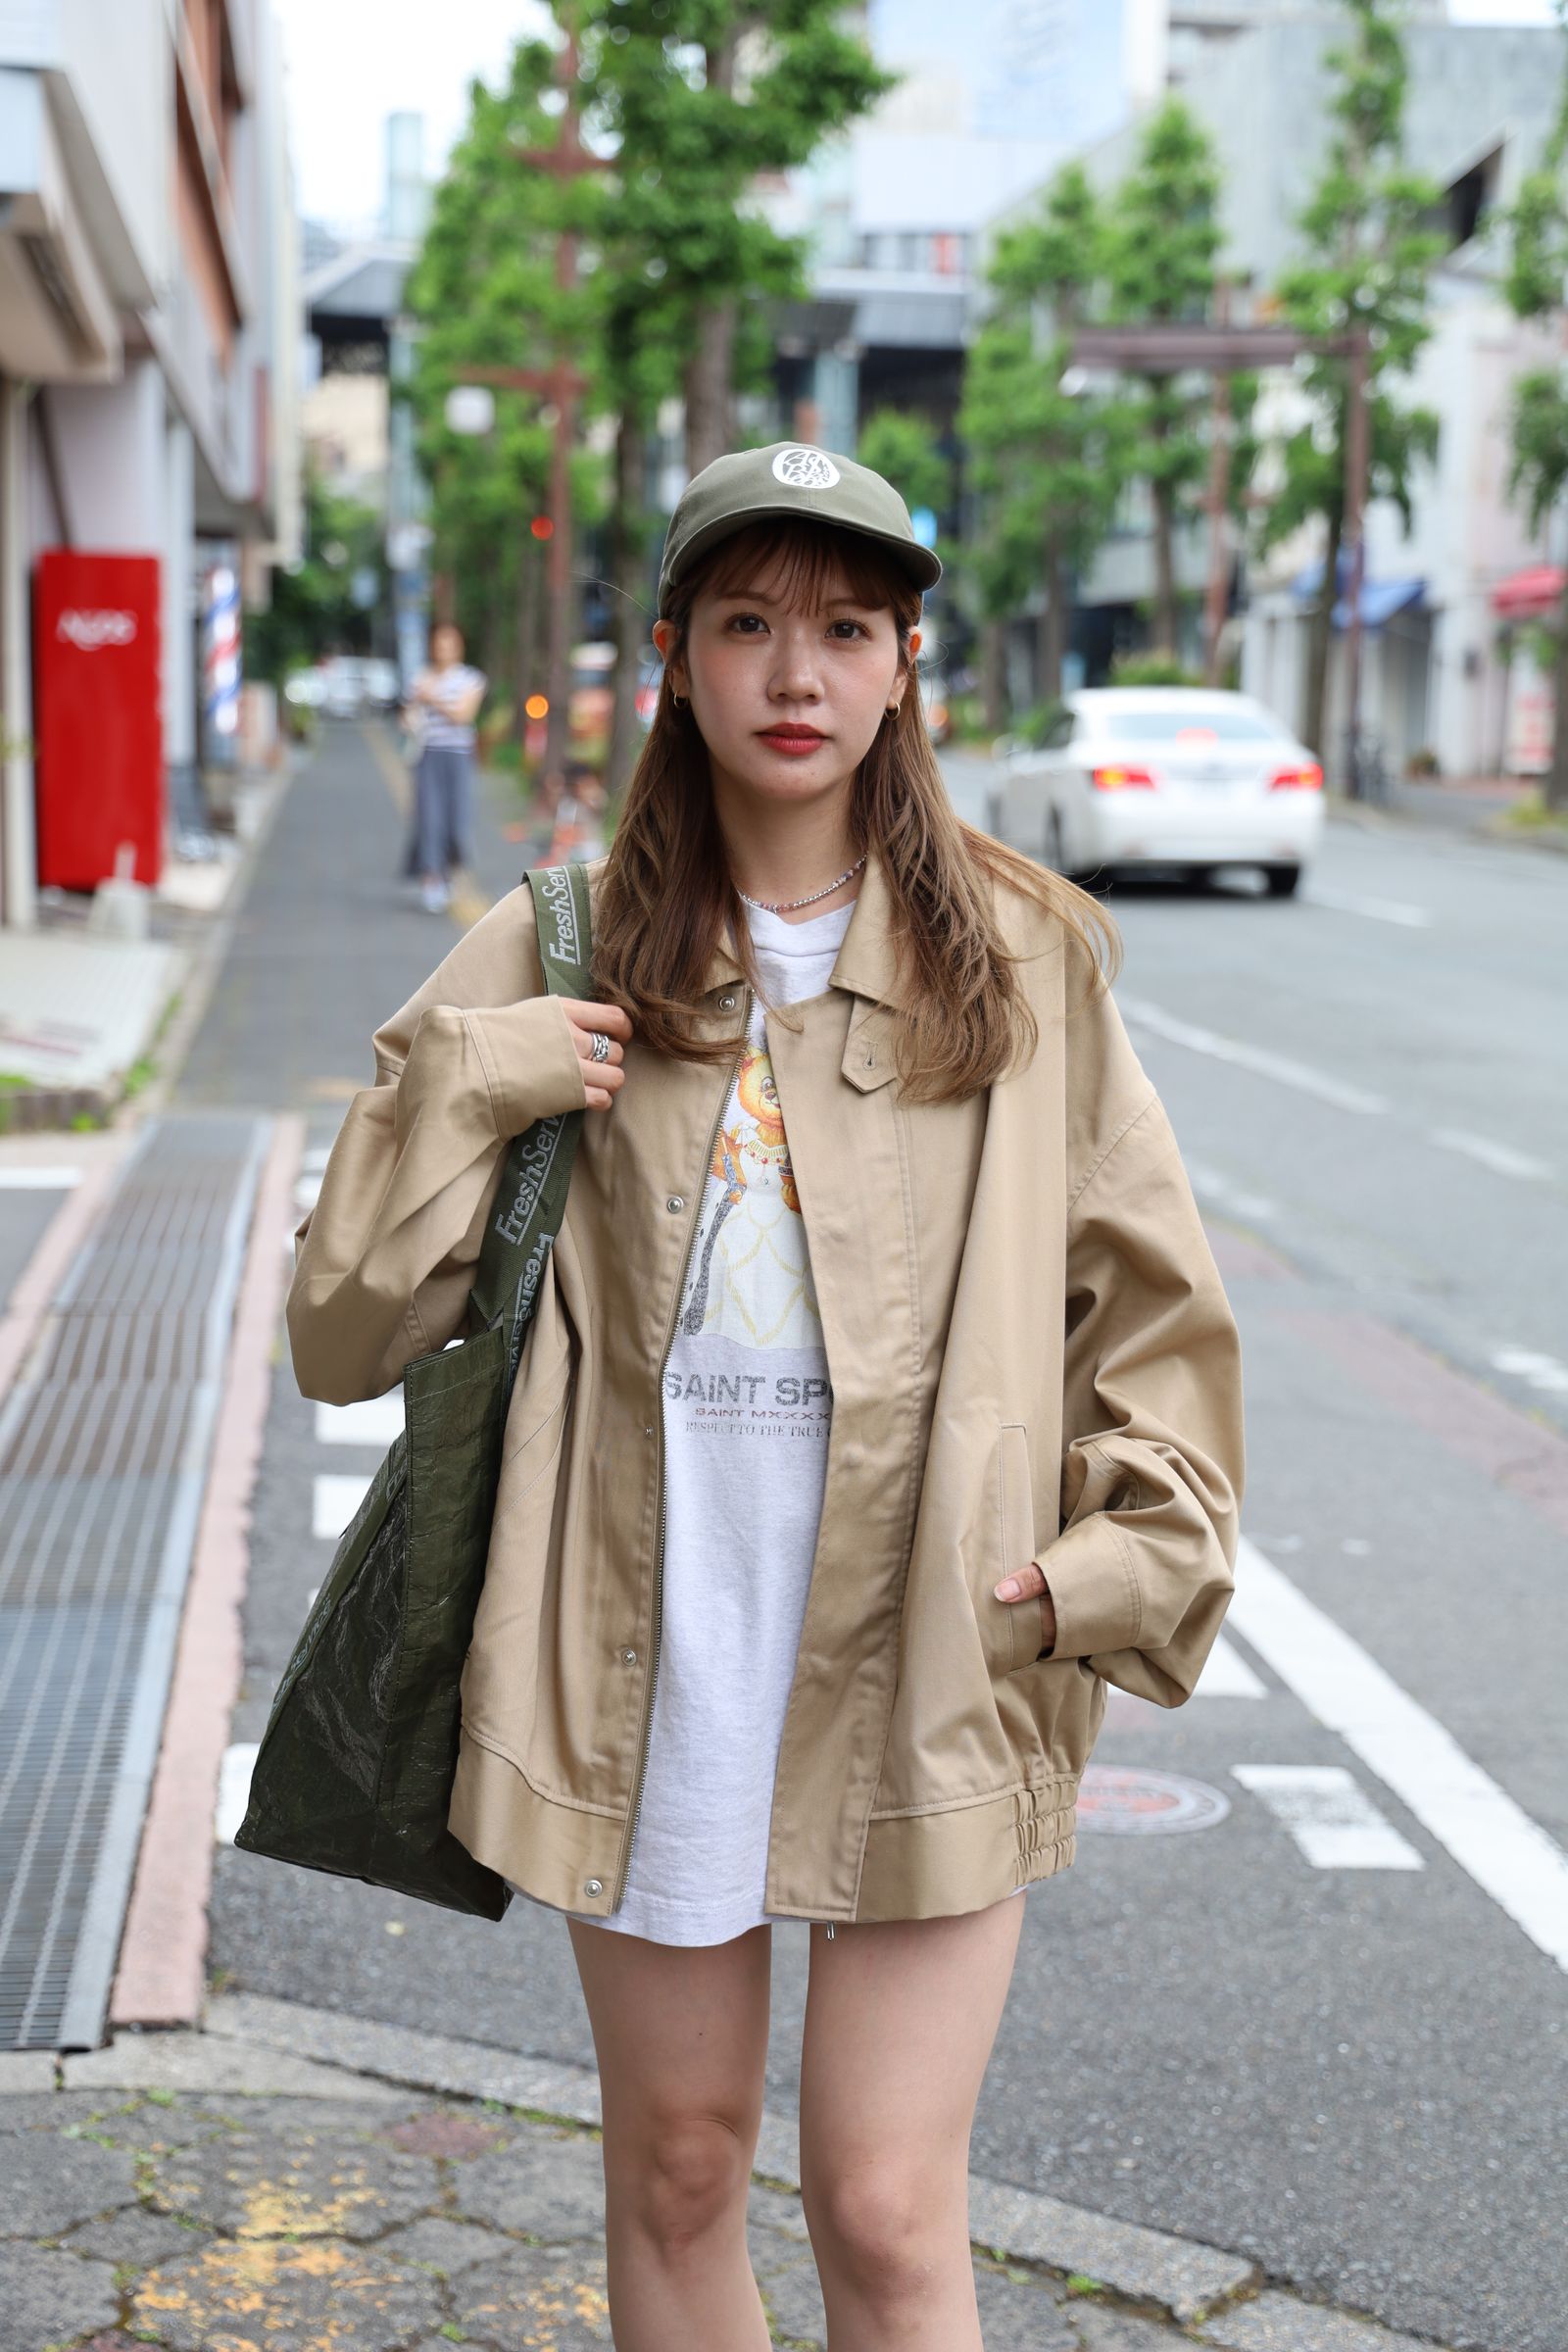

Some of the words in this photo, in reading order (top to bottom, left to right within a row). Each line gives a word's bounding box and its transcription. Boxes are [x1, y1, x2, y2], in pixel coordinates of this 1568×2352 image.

[664, 1372, 766, 1404] SAINT
[774, 1377, 834, 1406] SP
[695, 1407, 745, 1419] SAINT
[738, 1423, 756, 1436] TO
[760, 1424, 785, 1437] THE
[790, 1426, 824, 1439] TRUE
